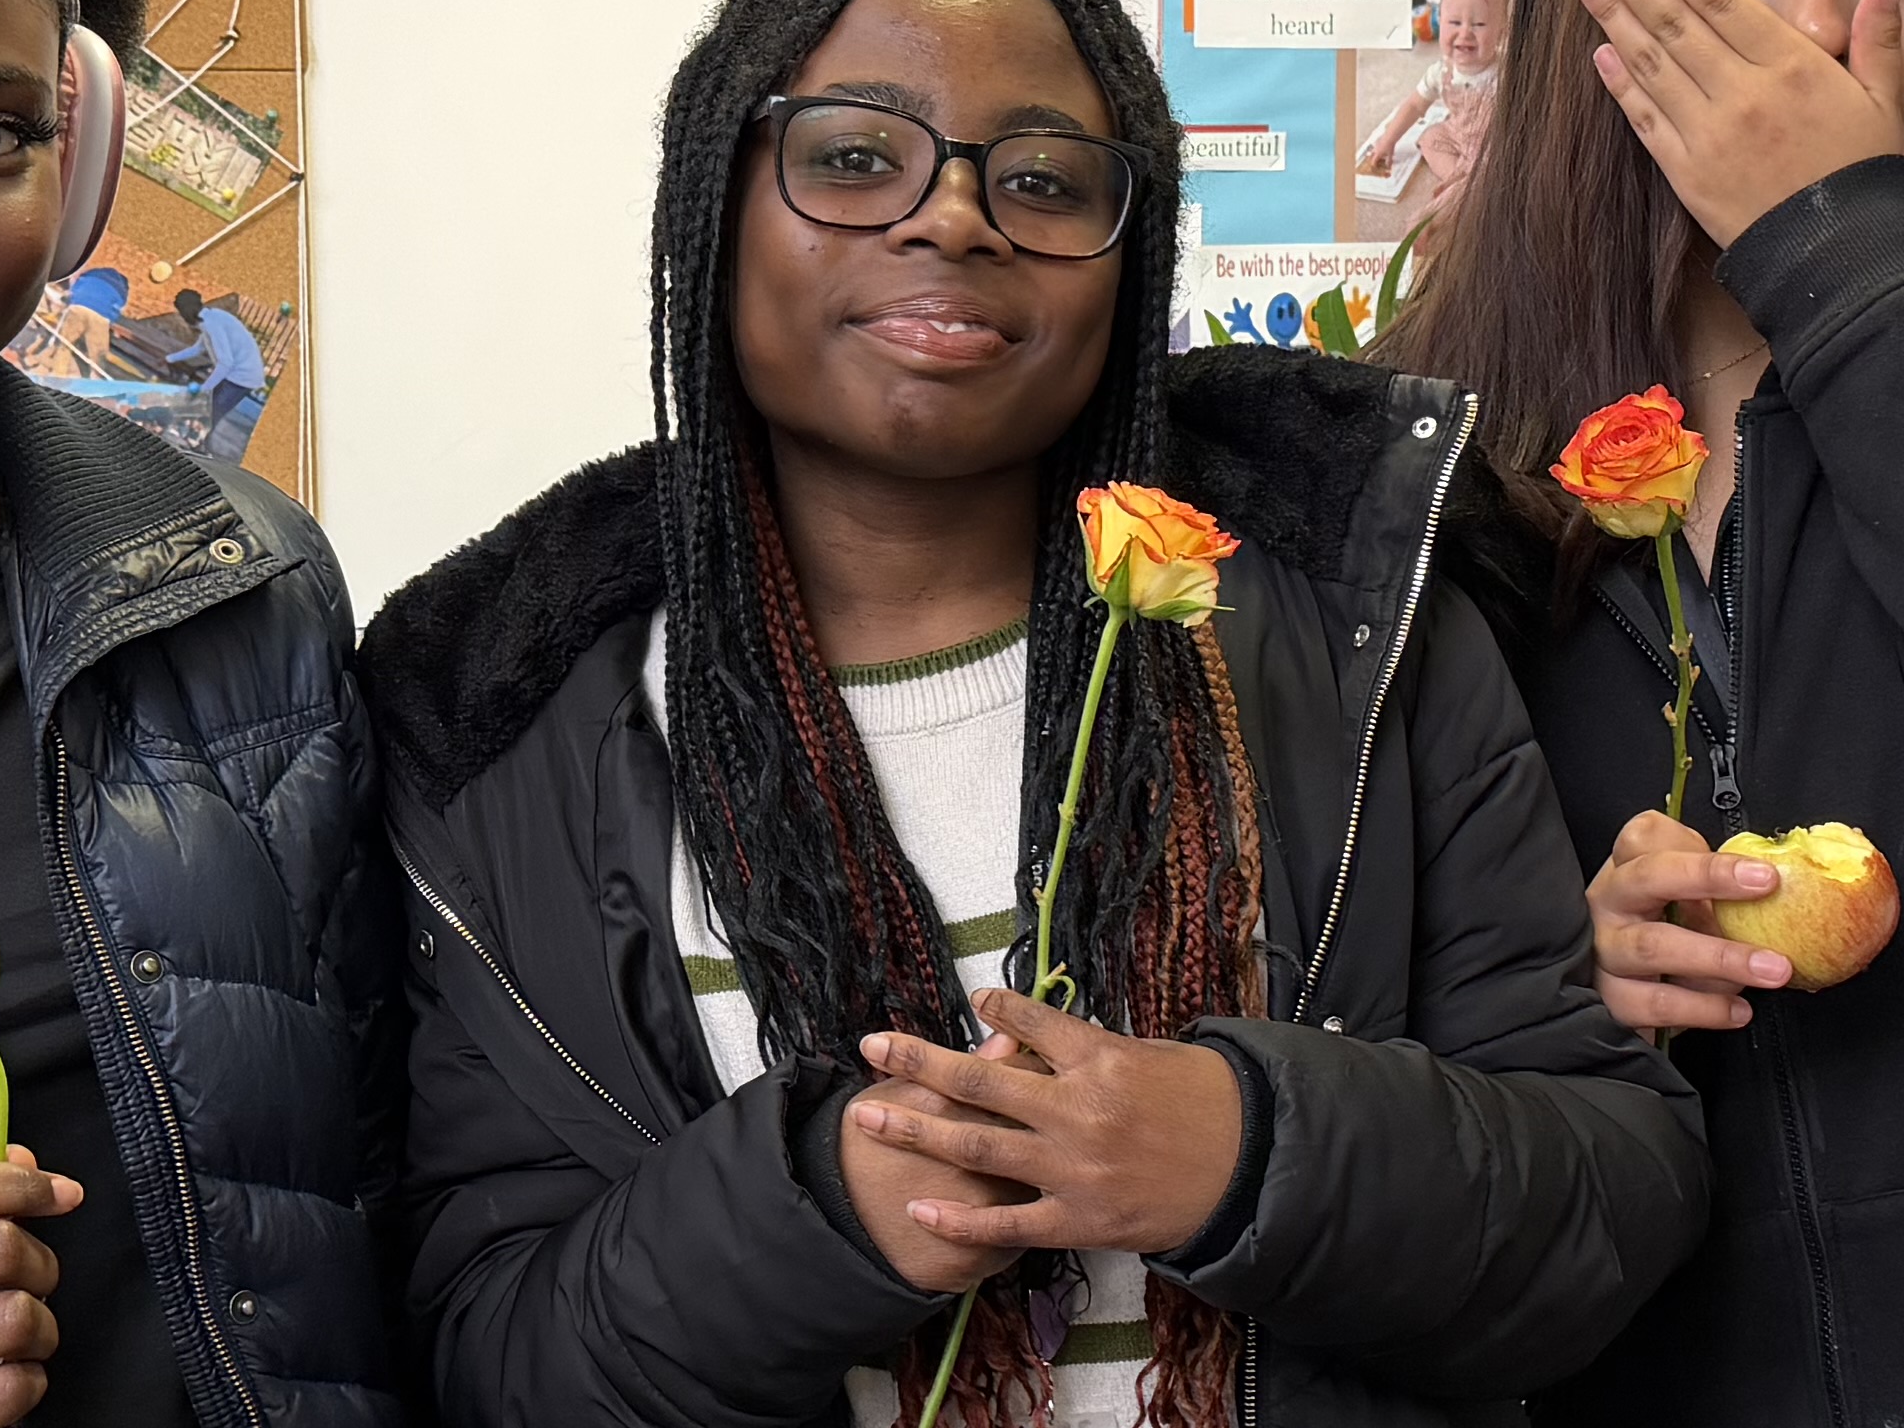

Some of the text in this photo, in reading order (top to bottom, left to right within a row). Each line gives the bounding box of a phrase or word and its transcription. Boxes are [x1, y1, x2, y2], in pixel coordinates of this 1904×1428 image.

[1271, 13, 1334, 36] heard
[1216, 254, 1235, 278] Be
[1240, 253, 1274, 278] with
[1279, 252, 1304, 276] the
[1309, 252, 1340, 277] best
